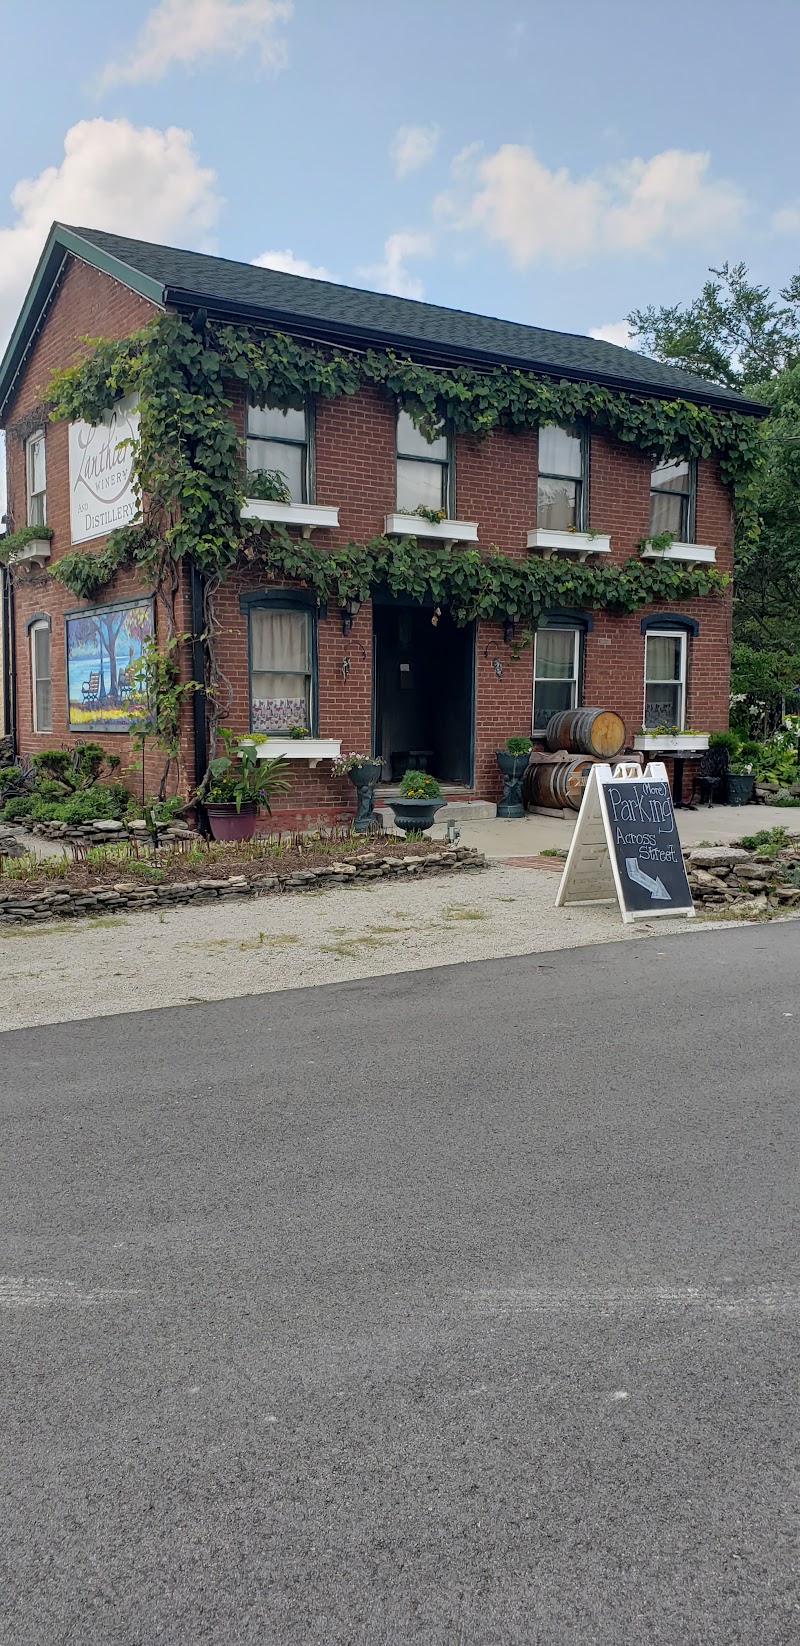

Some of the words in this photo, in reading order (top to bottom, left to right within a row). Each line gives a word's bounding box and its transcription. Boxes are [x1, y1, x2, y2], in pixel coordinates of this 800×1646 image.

[95, 468, 128, 492] WINERY
[85, 501, 135, 531] DISTILLERY
[616, 826, 657, 846] Across
[638, 844, 678, 862] Street
